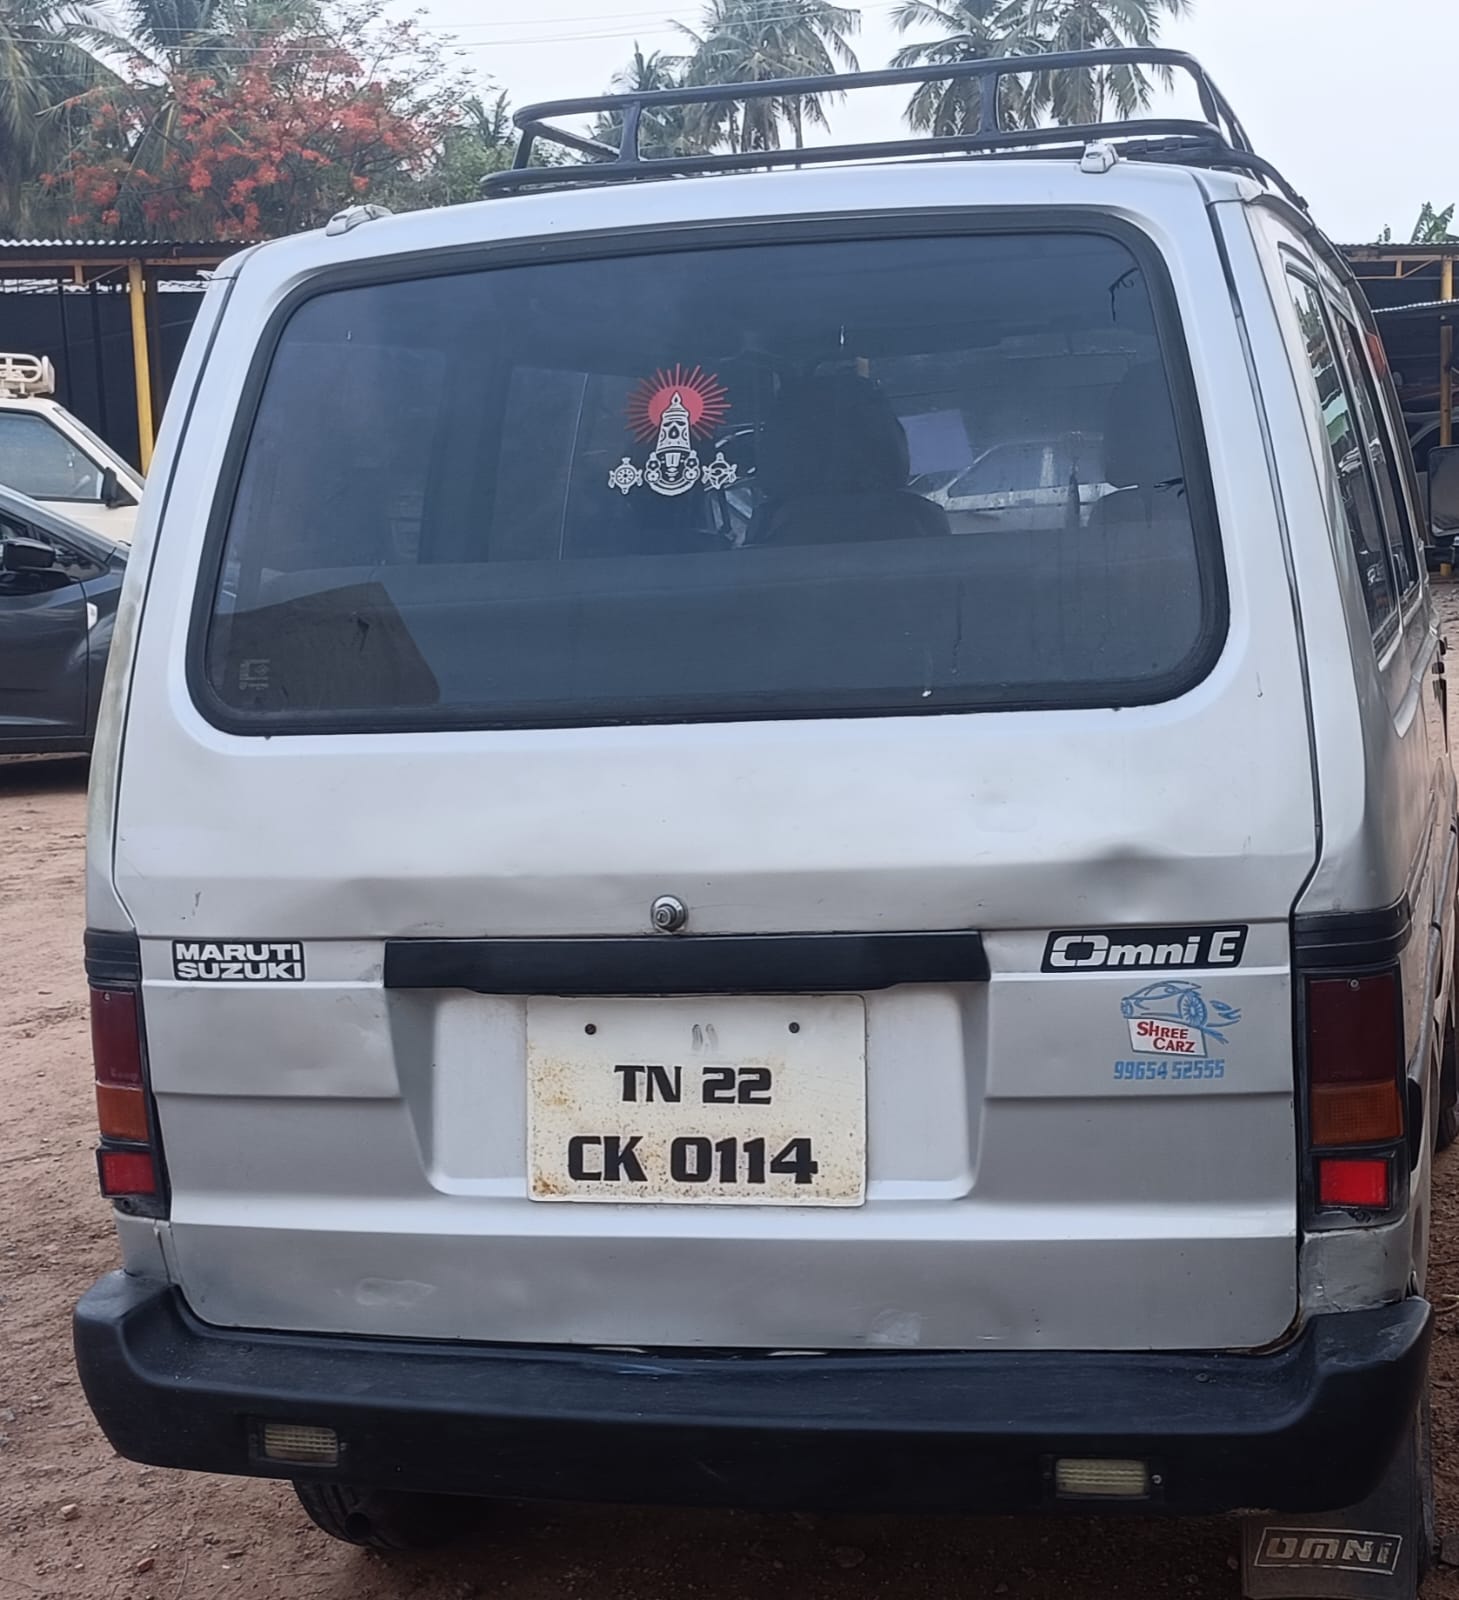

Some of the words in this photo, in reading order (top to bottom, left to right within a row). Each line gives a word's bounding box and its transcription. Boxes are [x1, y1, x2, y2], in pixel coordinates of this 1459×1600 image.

[175, 943, 301, 961] MARUTI
[1049, 934, 1201, 968] Omni
[1207, 930, 1241, 963] E
[177, 962, 303, 979] SUZUKI
[1136, 1020, 1189, 1040] SHREE
[1152, 1037, 1195, 1053] CARZ
[1113, 1061, 1167, 1080] 99654
[1171, 1060, 1225, 1080] 52555
[614, 1065, 682, 1103] TN
[702, 1067, 772, 1105] 22
[568, 1136, 648, 1182] CK
[670, 1137, 818, 1184] 0114
